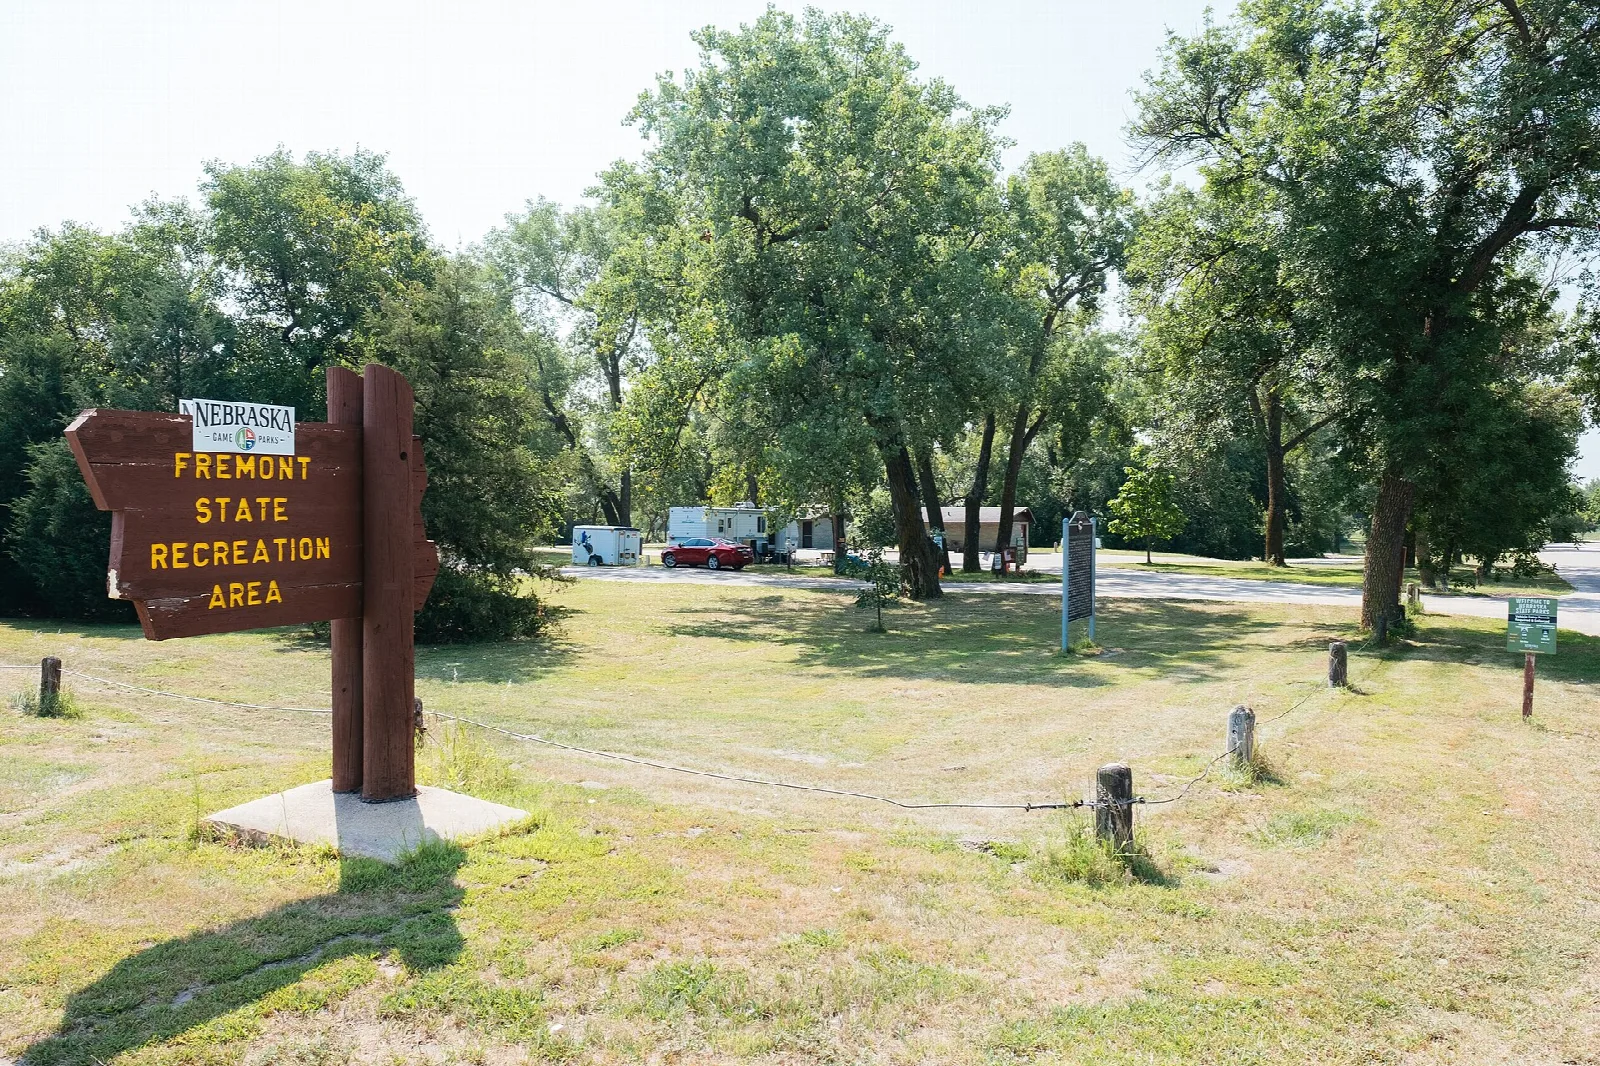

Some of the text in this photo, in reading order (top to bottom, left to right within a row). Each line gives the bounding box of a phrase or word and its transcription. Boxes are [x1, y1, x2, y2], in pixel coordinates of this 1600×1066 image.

[195, 402, 293, 433] NEBRASKA
[212, 432, 279, 445] GAME PARKS
[174, 452, 311, 480] FREMONT
[195, 497, 289, 524] STATE
[151, 537, 331, 570] RECREATION
[208, 579, 283, 610] AREA
